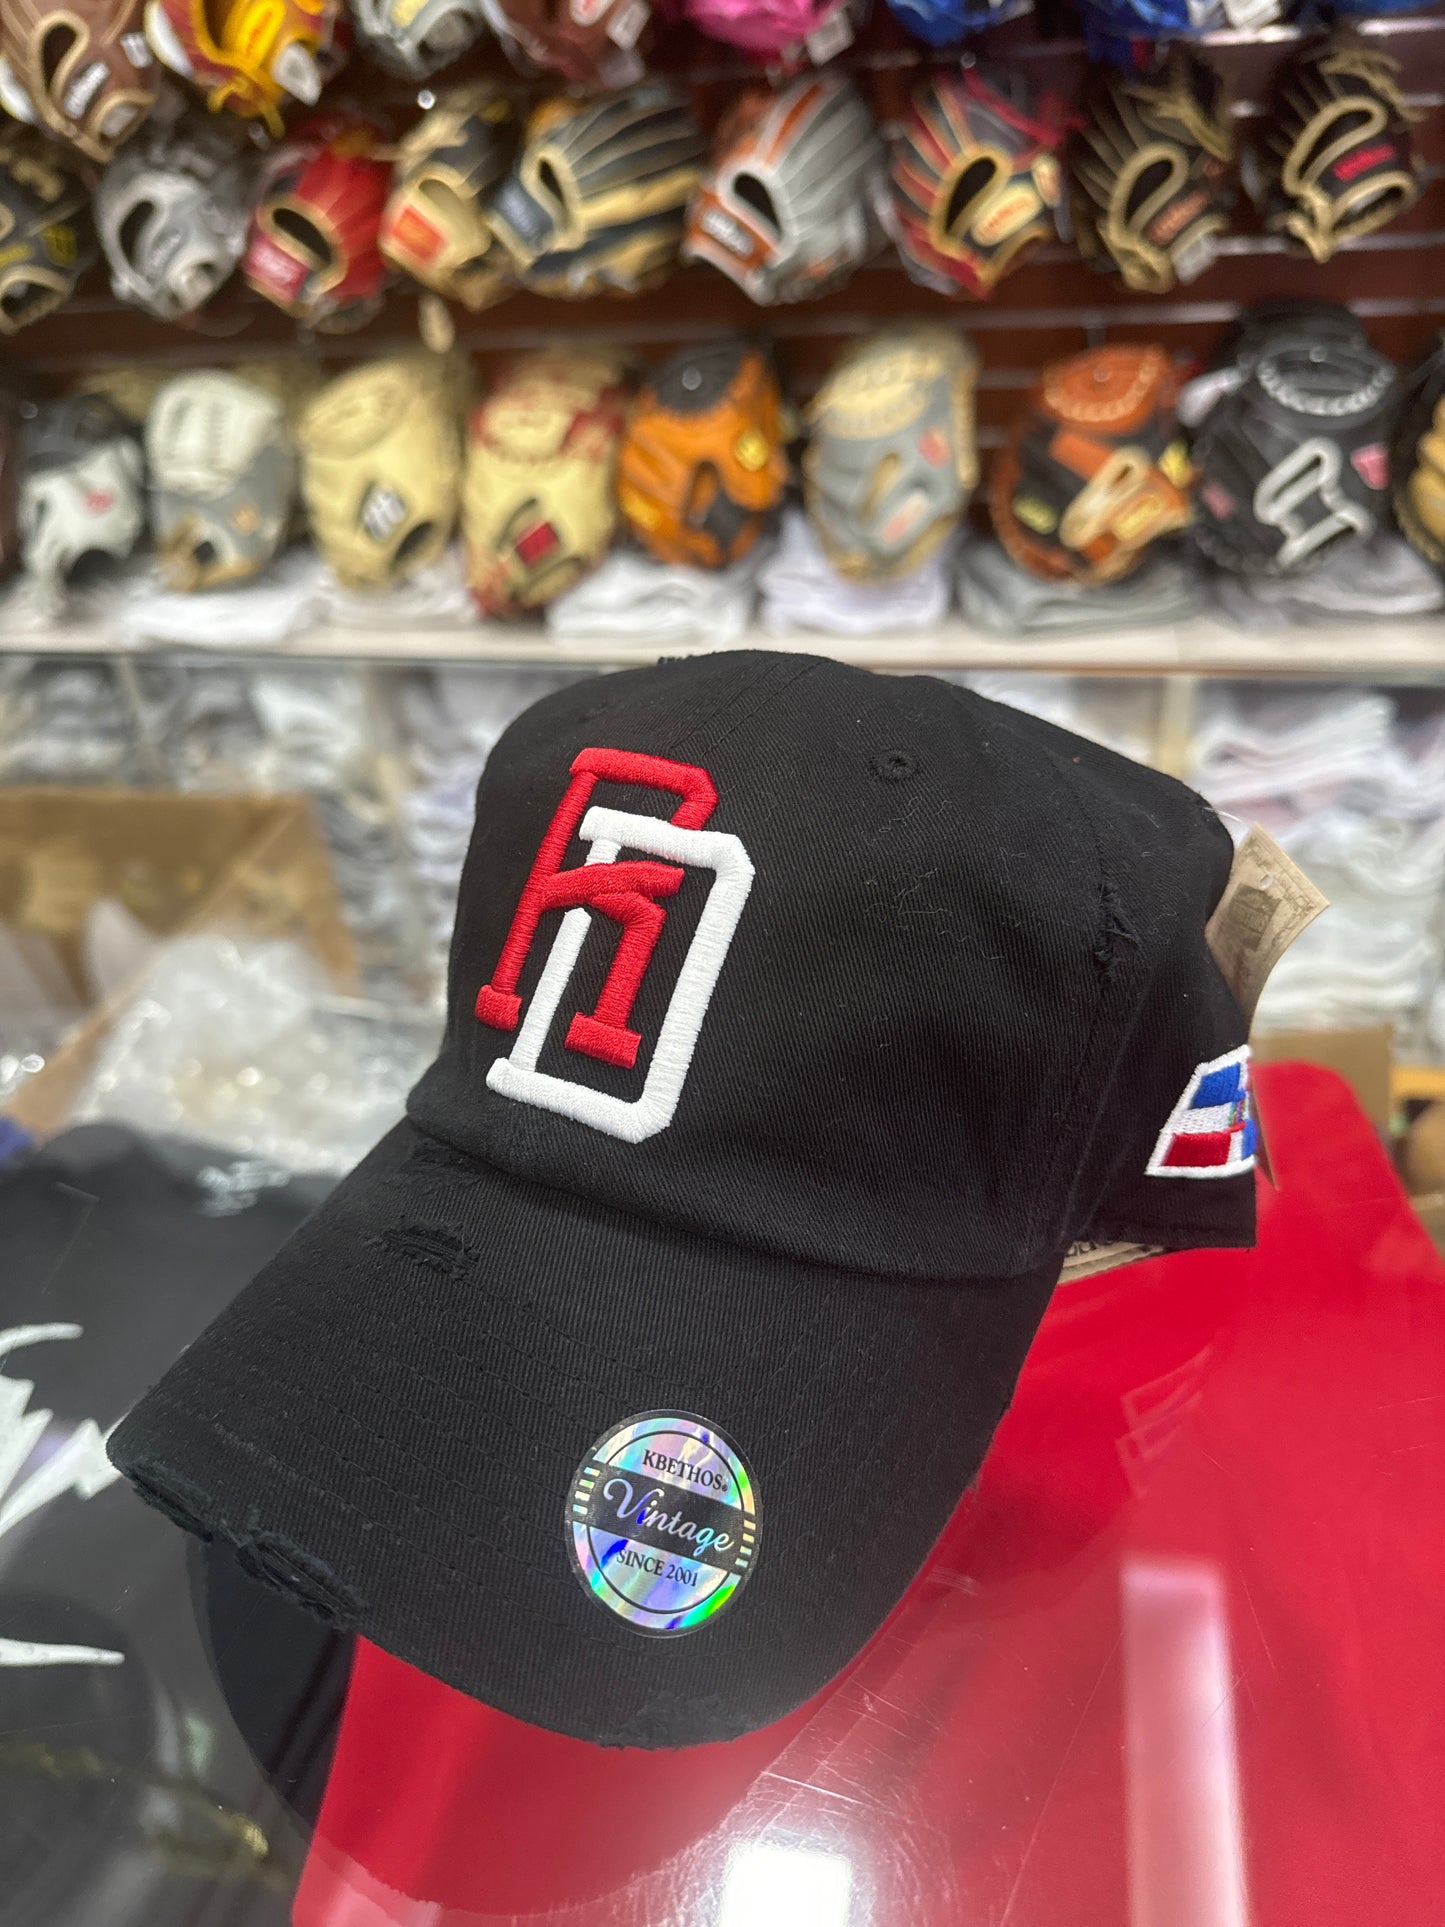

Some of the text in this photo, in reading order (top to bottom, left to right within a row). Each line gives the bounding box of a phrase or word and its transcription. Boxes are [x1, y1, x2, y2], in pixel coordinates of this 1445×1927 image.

[603, 1478, 735, 1556] Vintage
[616, 1549, 698, 1588] SINCE 2001
